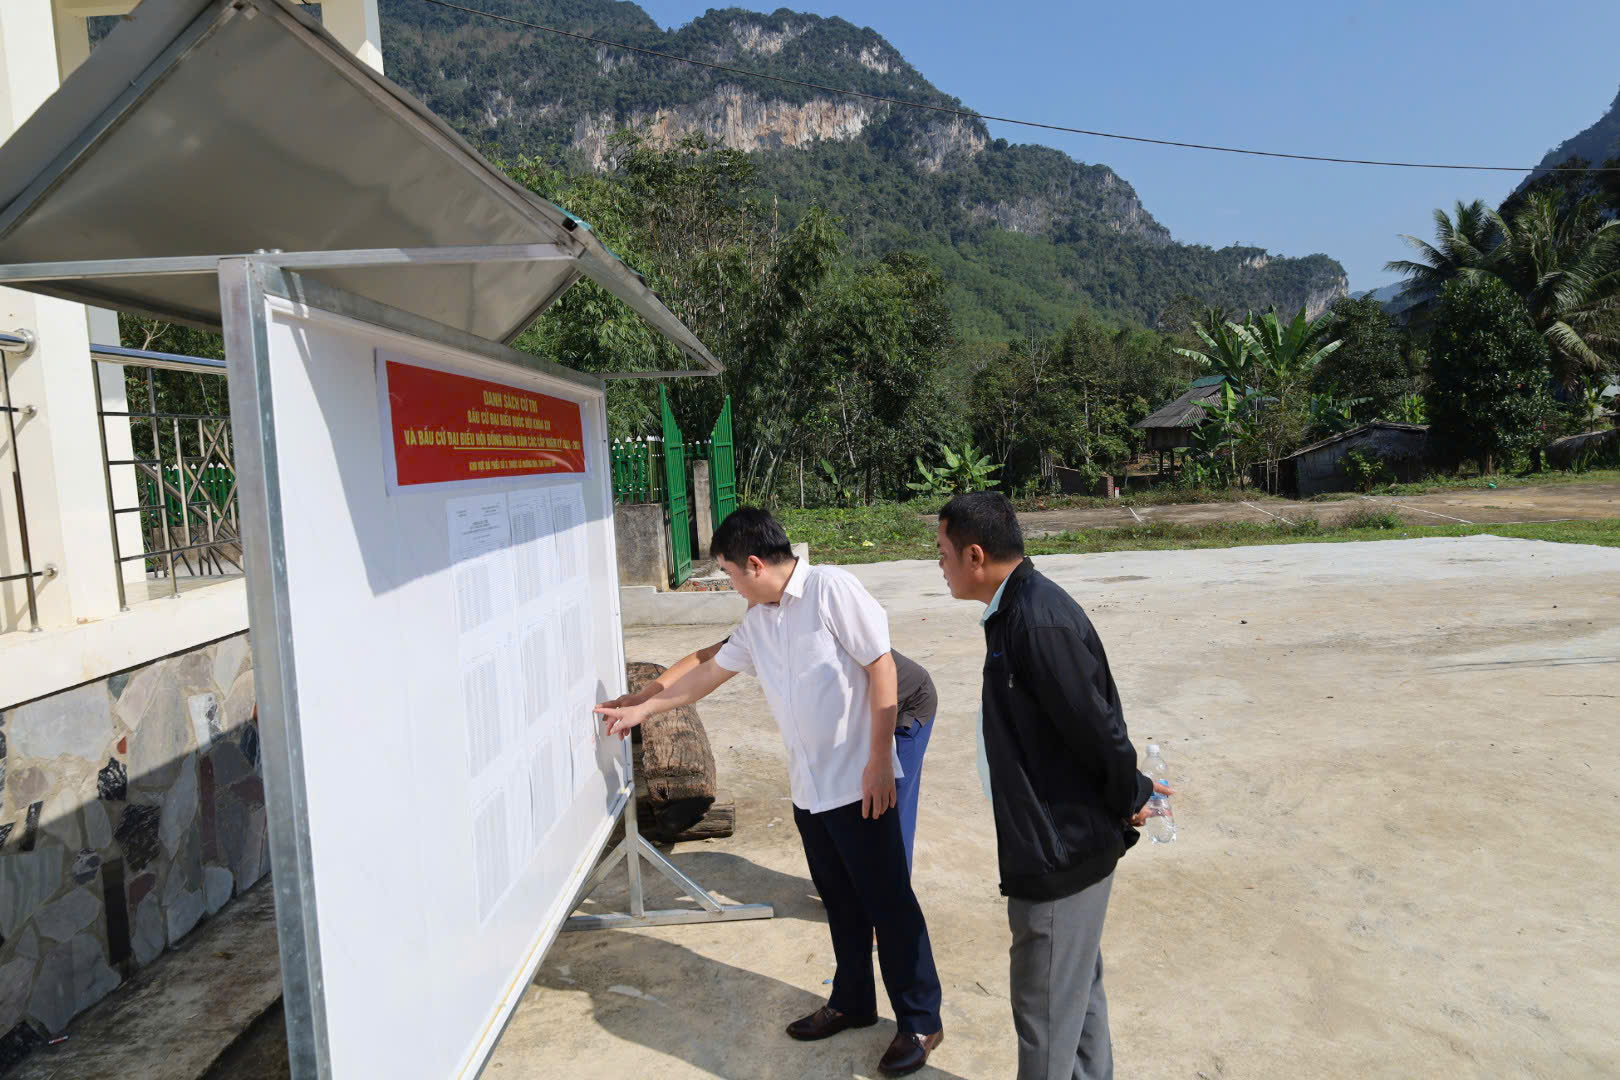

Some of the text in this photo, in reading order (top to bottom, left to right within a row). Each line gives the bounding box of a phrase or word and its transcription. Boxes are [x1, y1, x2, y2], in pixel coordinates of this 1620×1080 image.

[483, 390, 502, 408] DANH
[404, 426, 418, 446] VÀ
[418, 426, 434, 446] BẦU
[436, 426, 447, 446] CỬ
[460, 428, 474, 446] BIỂU
